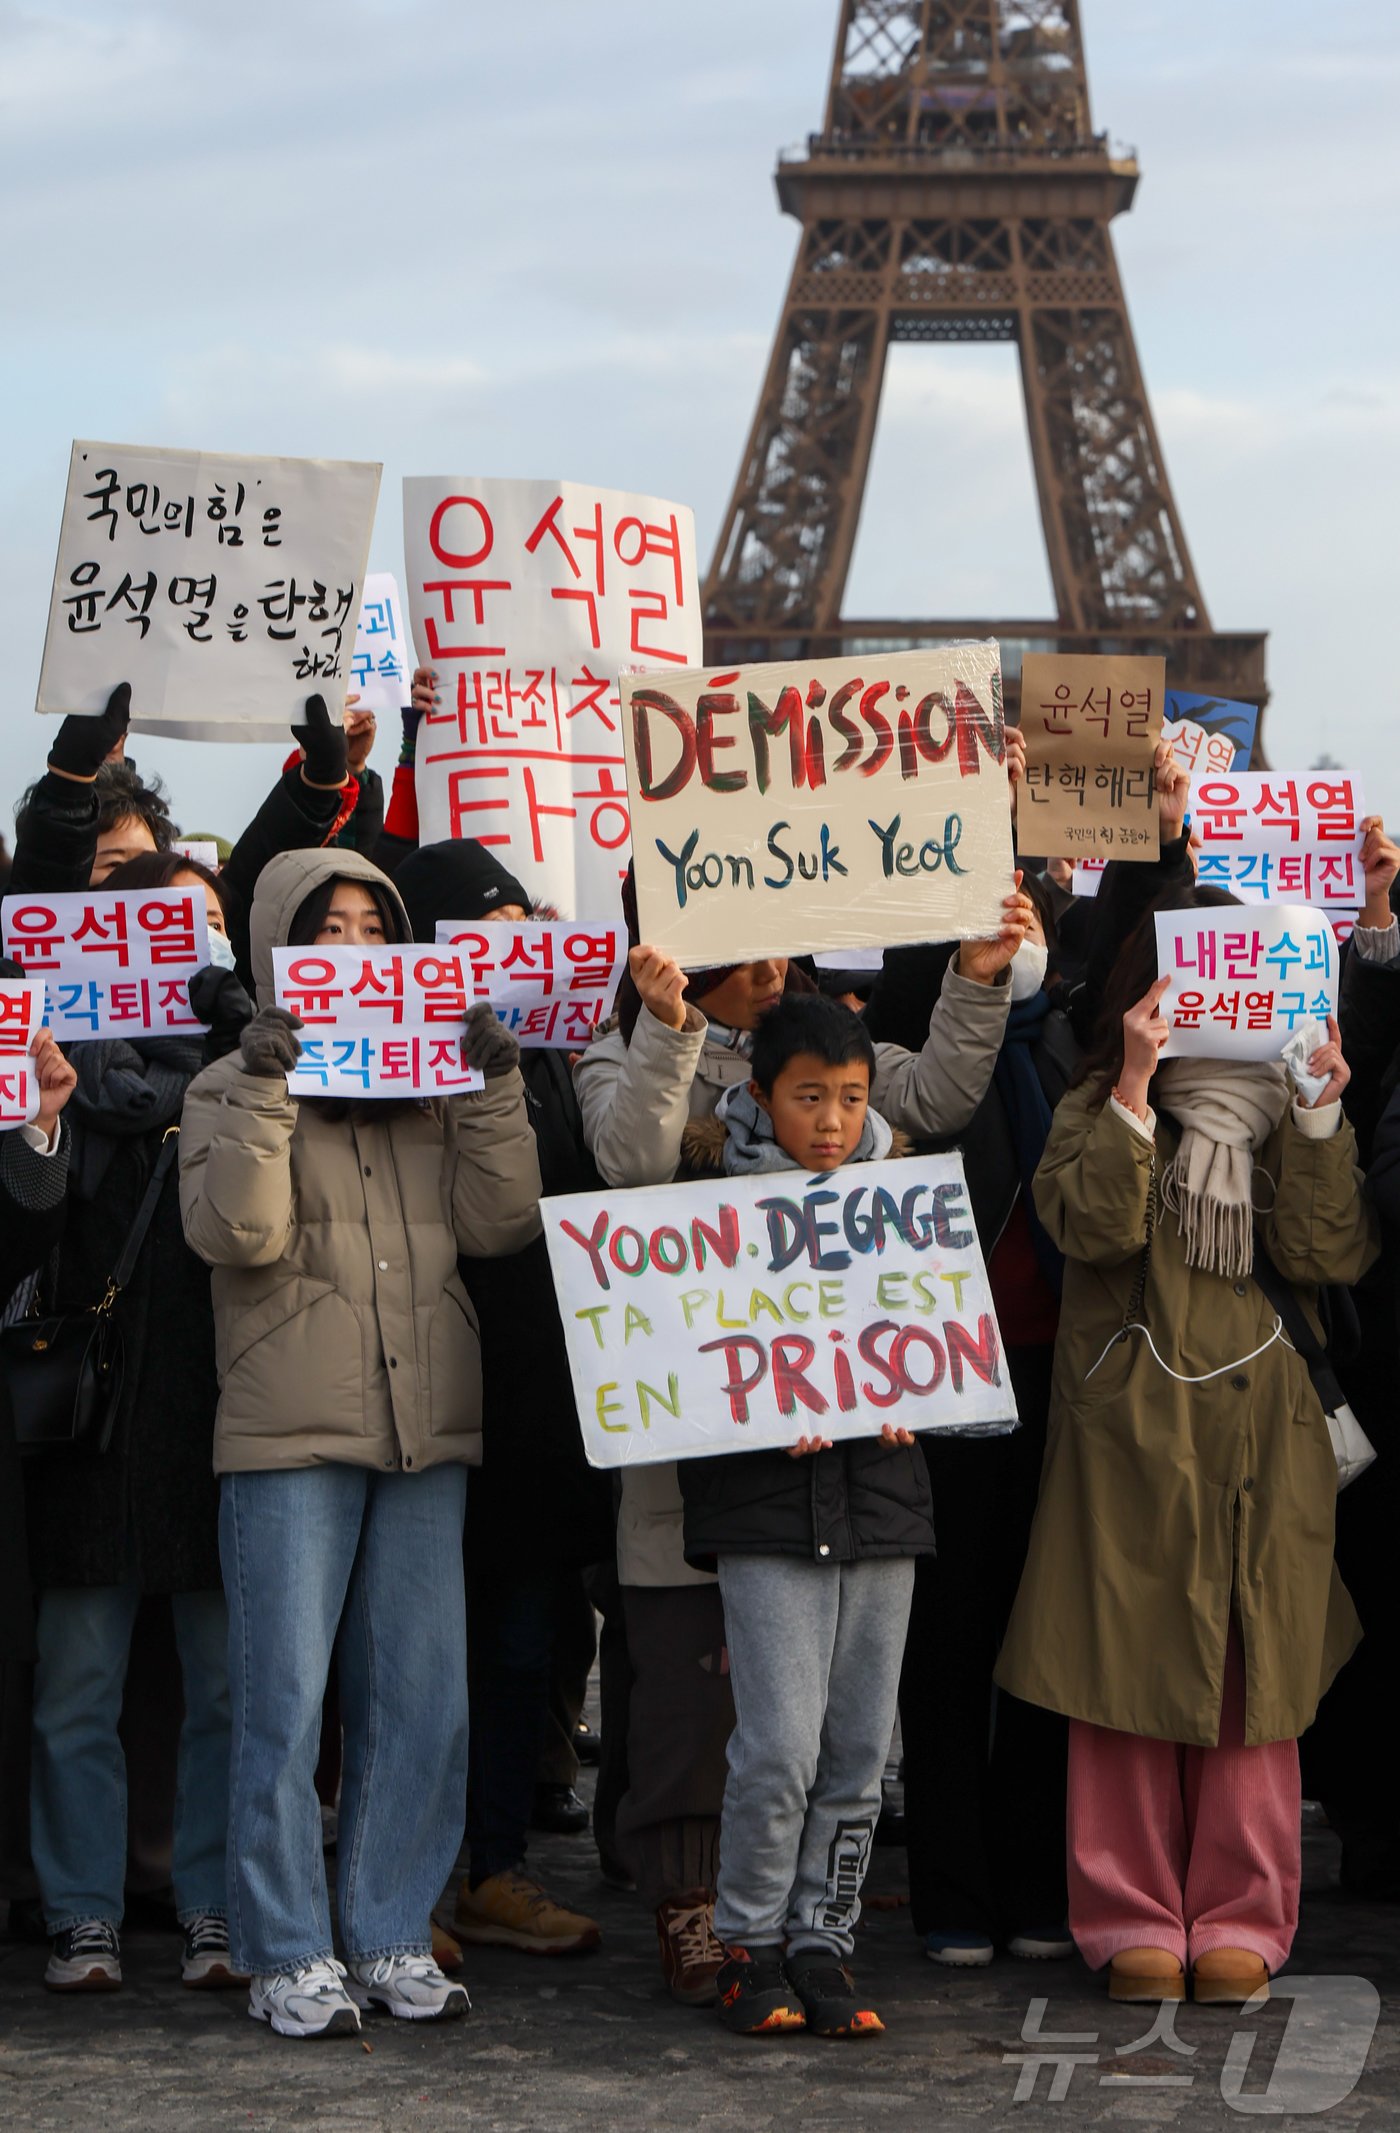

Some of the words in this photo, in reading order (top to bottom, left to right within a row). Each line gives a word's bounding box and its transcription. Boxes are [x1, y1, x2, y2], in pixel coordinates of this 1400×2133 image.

[257, 577, 354, 652] 탄핵
[423, 496, 687, 664] 윤석열
[1040, 683, 1151, 738] 윤석열
[1196, 779, 1356, 842] 윤석열
[655, 829, 755, 908] Yoon
[763, 820, 848, 889] Suk
[867, 812, 975, 881] Yeol
[8, 898, 198, 970] 윤석열
[42, 976, 201, 1031] 각퇴진
[282, 956, 467, 1024] 윤석열
[755, 1172, 974, 1272] DÉGAGE
[575, 1304, 654, 1349] TA
[678, 1279, 846, 1329] PLACE
[877, 1270, 972, 1315] EST
[596, 1372, 682, 1433] EN
